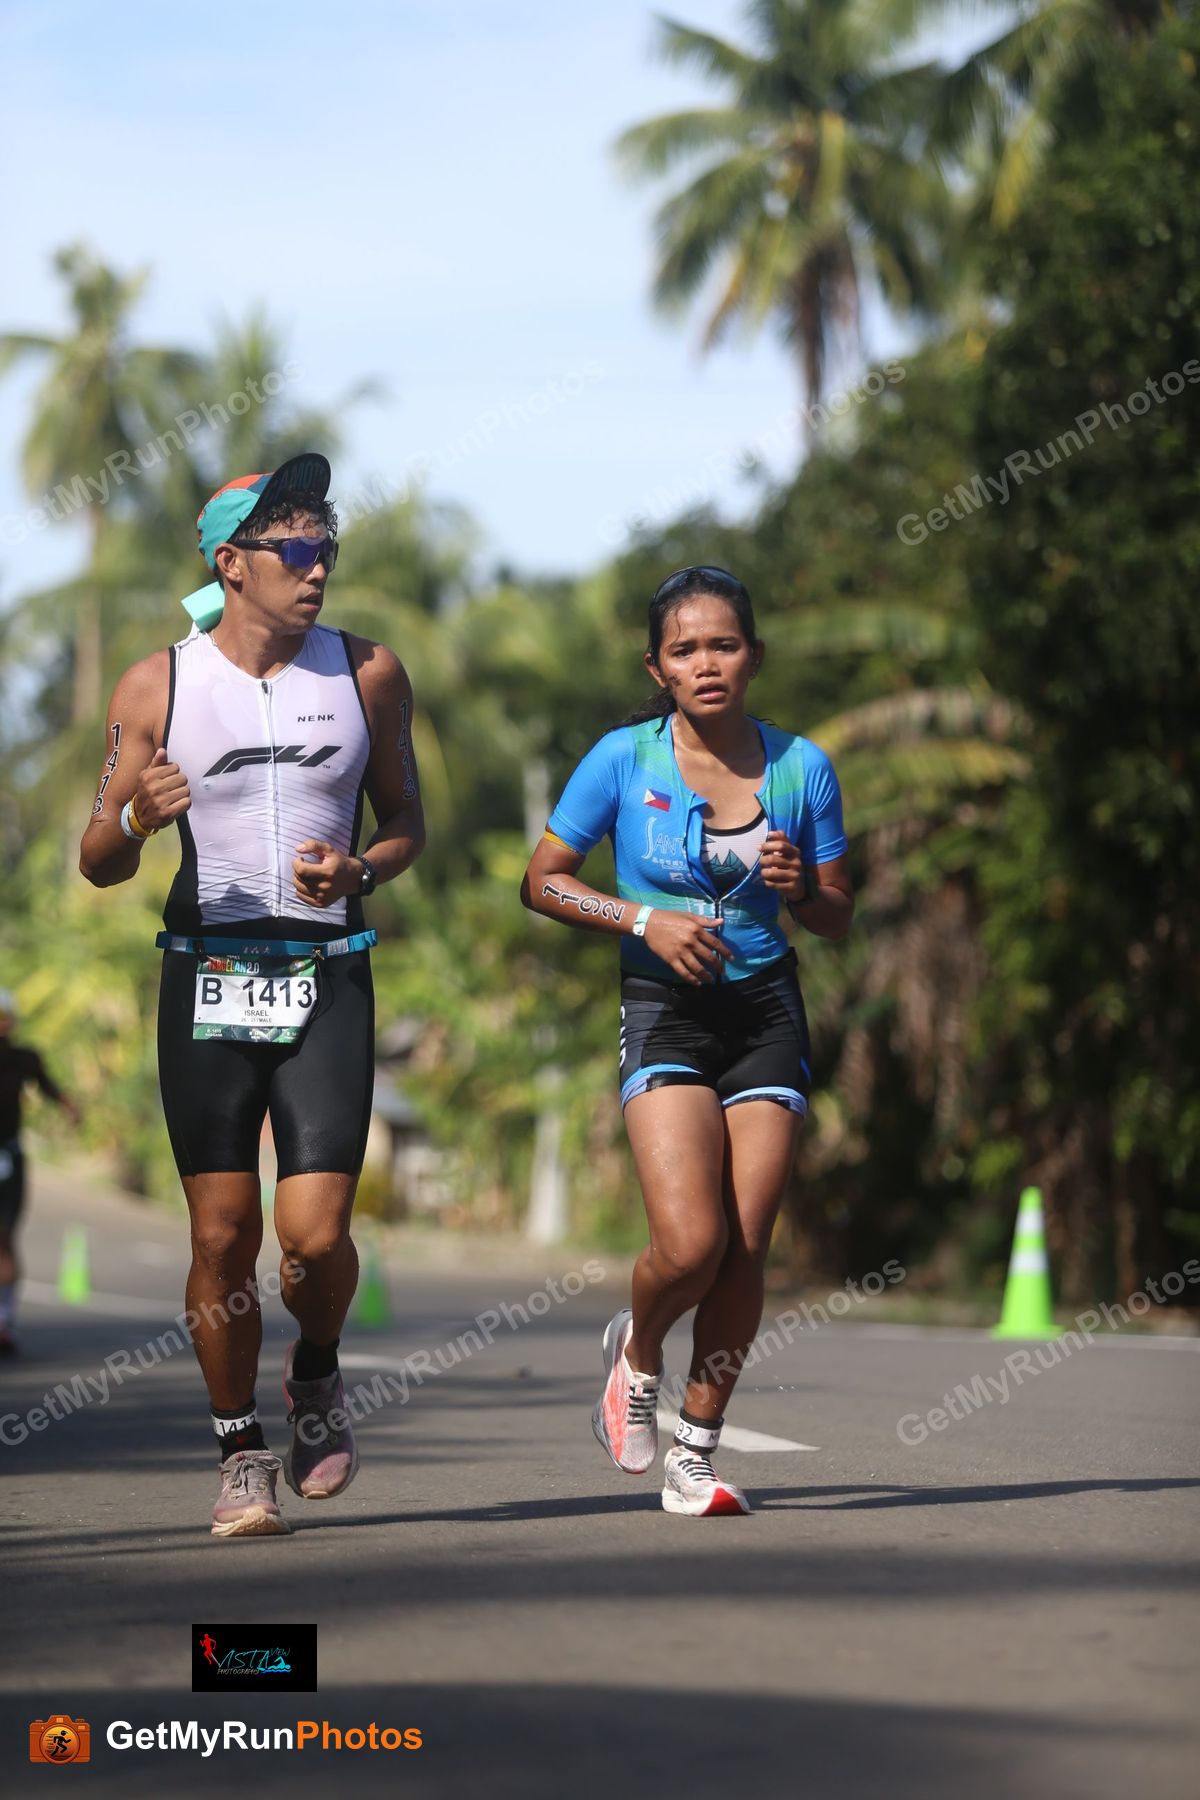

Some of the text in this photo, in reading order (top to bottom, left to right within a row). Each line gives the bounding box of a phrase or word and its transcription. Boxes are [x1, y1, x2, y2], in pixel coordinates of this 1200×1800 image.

[297, 713, 336, 723] NENK
[92, 722, 121, 815] 1413
[542, 883, 625, 923] 1192
[201, 977, 313, 1009] B 1413
[244, 1009, 269, 1017] ISRAEL
